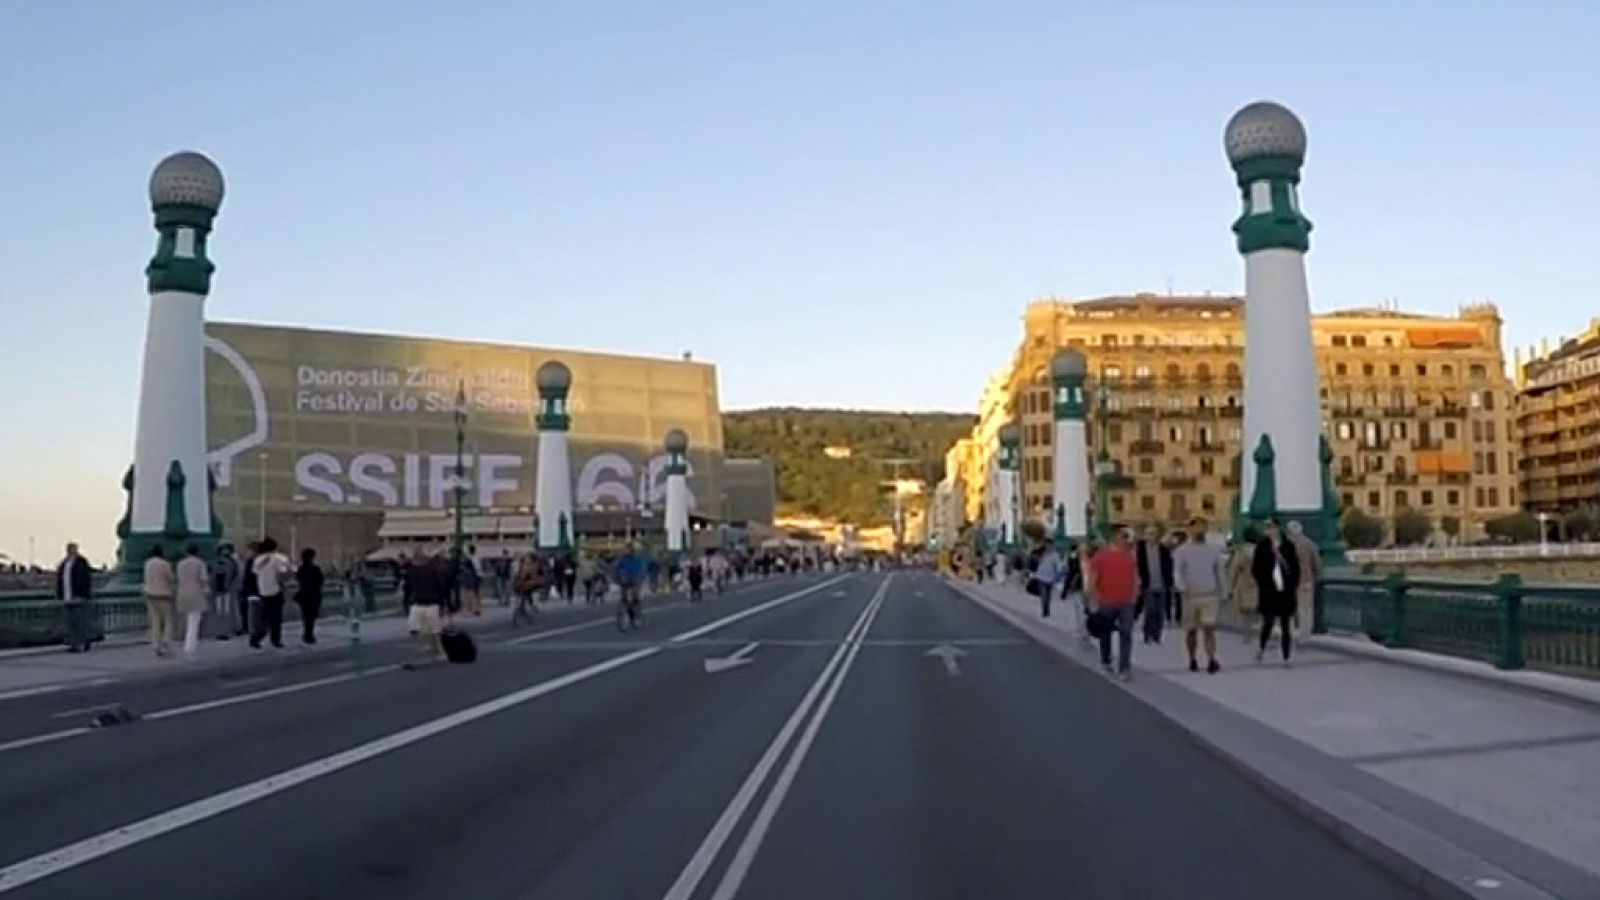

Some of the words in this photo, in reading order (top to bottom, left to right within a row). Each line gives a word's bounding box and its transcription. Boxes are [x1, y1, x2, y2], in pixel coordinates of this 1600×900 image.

[297, 365, 400, 388] Donostia
[296, 390, 384, 412] Festival
[390, 389, 419, 412] de
[474, 390, 587, 414] Seban
[295, 452, 522, 508] SSIFF
